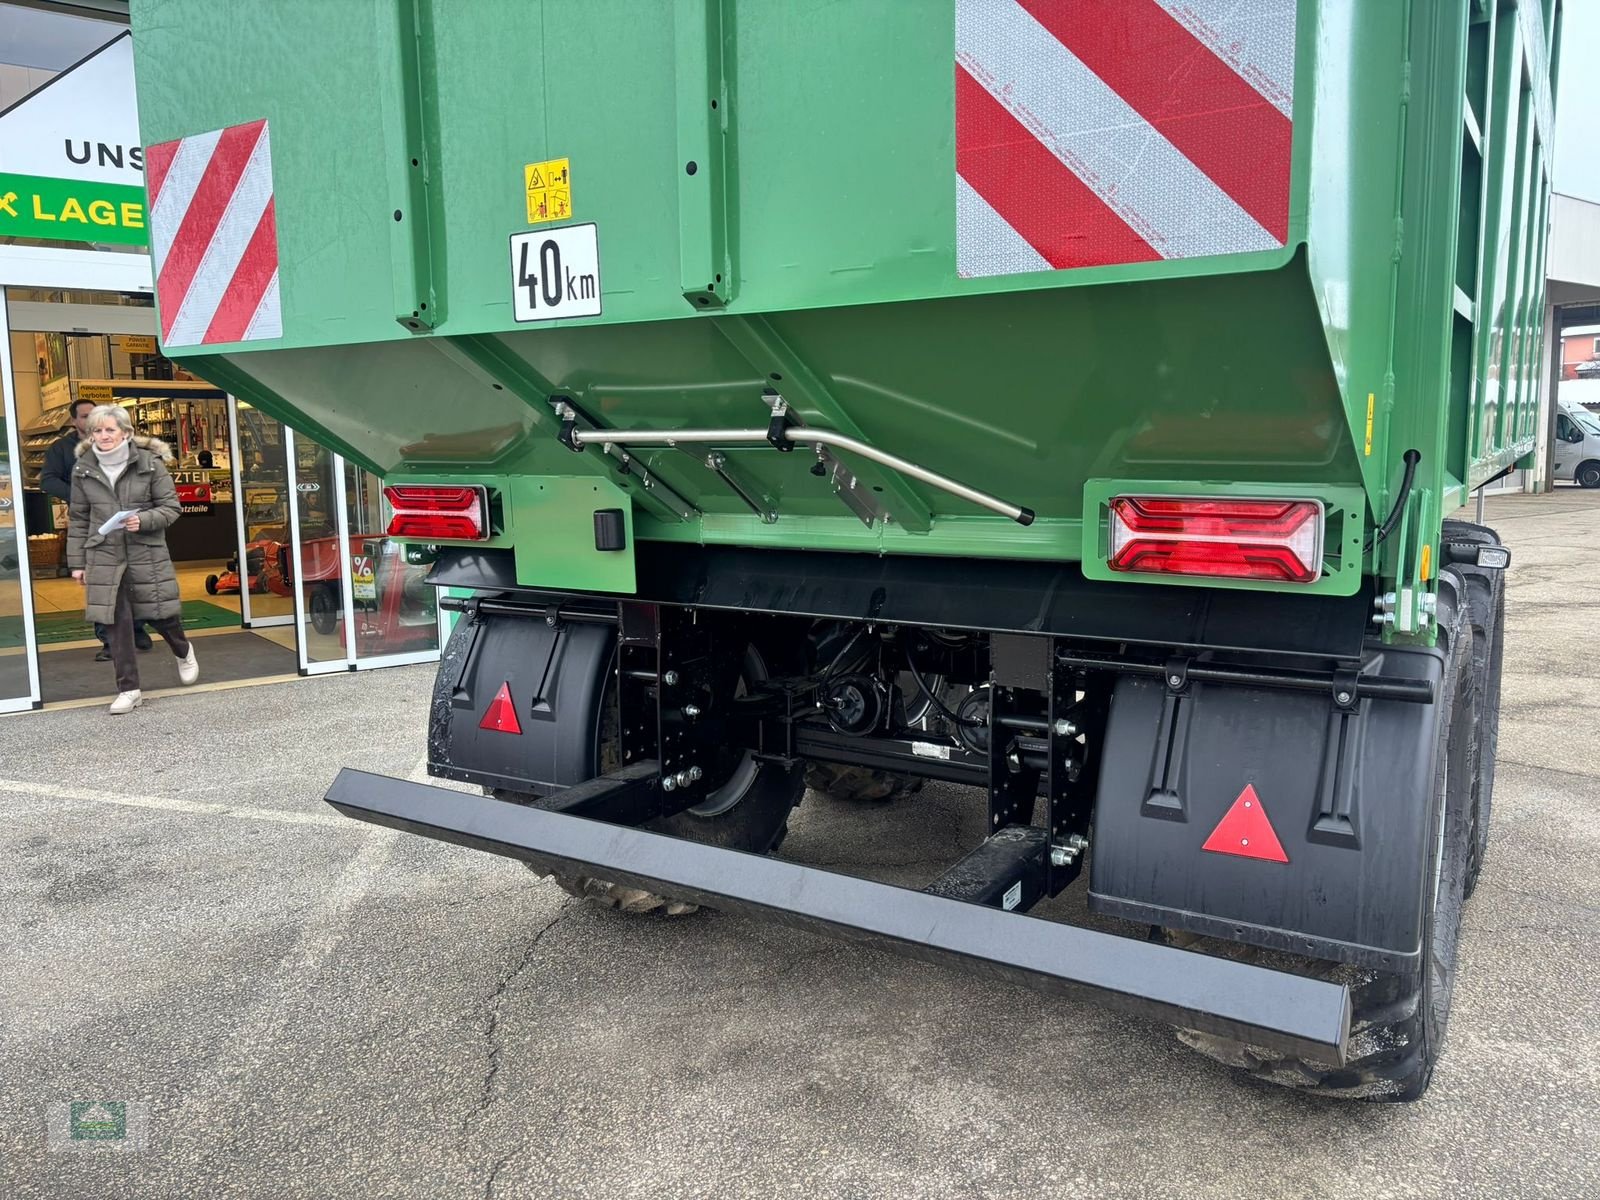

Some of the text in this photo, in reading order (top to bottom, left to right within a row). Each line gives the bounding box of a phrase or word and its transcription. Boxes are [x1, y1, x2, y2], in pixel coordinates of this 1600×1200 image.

[32, 194, 145, 228] LAGE
[518, 239, 596, 309] 40 km
